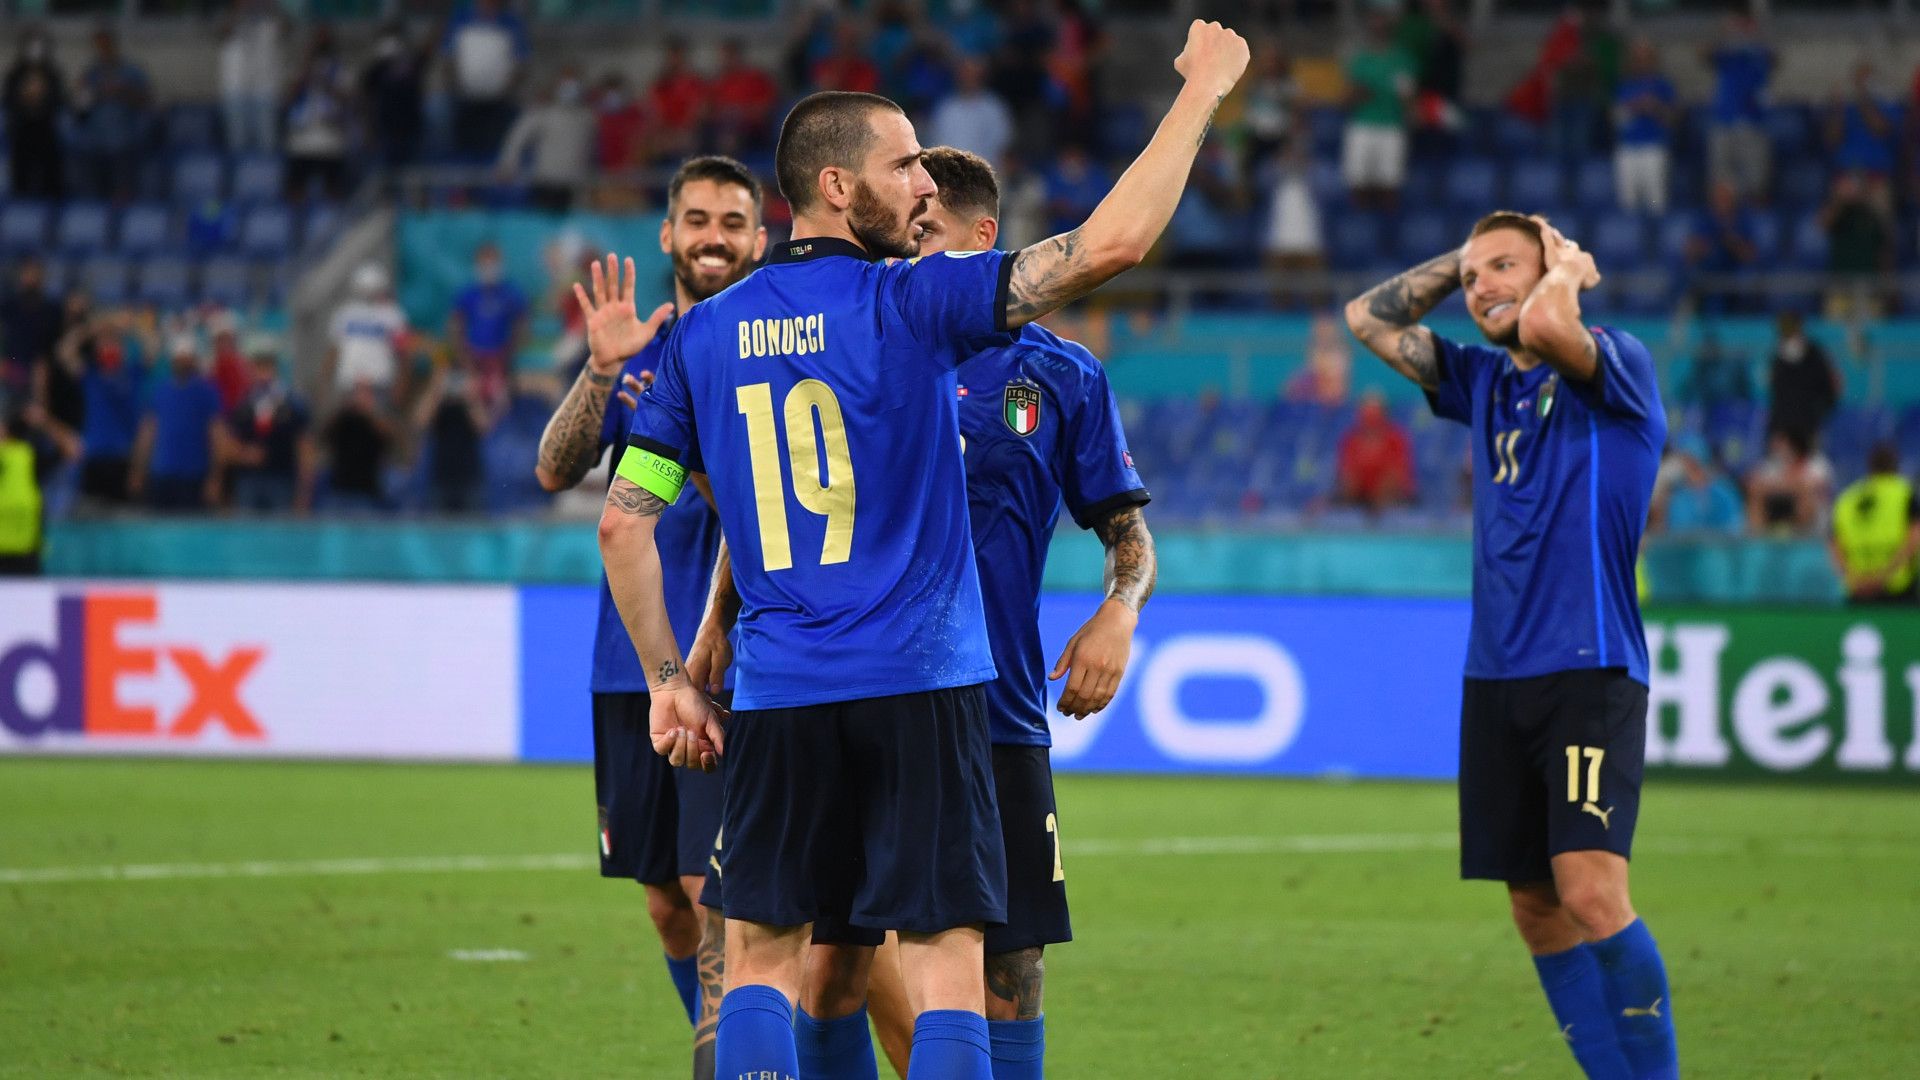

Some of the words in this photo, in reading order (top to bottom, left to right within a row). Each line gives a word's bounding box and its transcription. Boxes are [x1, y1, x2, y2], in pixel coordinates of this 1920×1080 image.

[790, 244, 813, 255] ITALIA
[738, 313, 825, 359] BONUCCI
[1008, 389, 1037, 401] ITALIA
[736, 378, 856, 572] 19
[1646, 622, 1920, 771] Hei
[1565, 745, 1605, 802] 17
